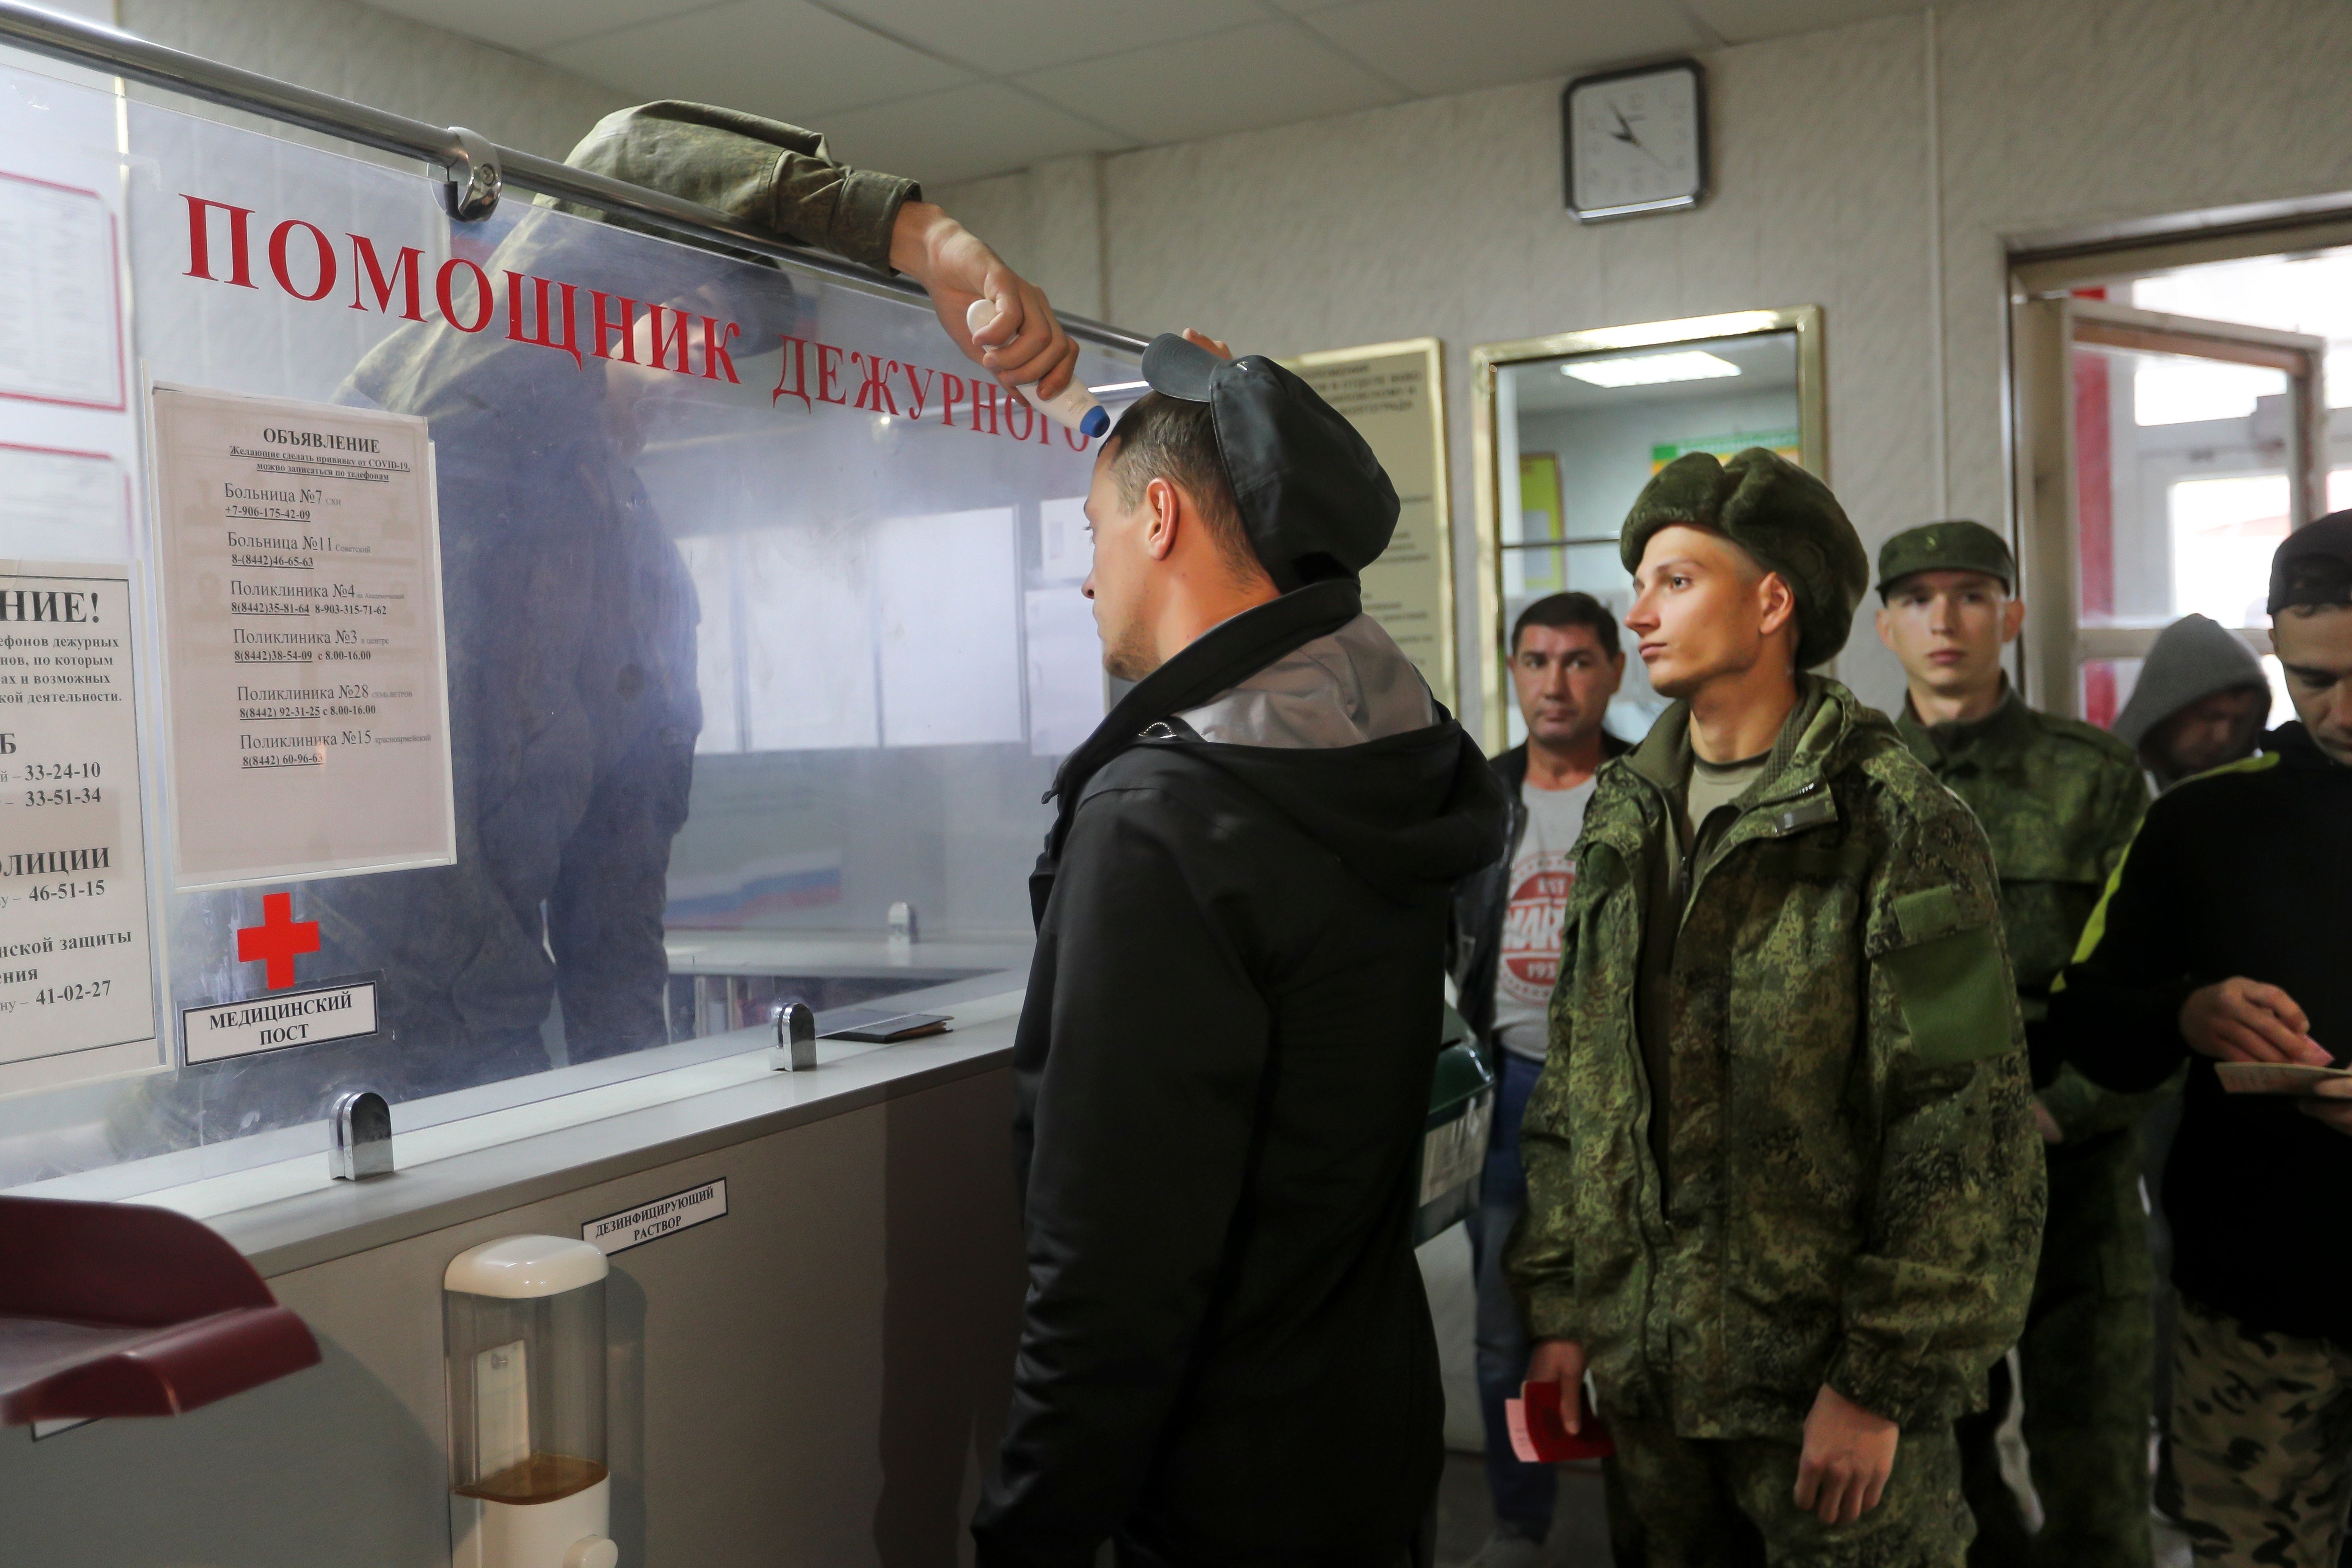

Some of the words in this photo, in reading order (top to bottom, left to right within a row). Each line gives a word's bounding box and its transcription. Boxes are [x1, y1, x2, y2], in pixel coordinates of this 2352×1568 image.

[178, 193, 742, 384] ПОМОЩНИК
[263, 428, 380, 453] ОБЪЯВЛЕНИЕ
[230, 445, 280, 458] Желающие
[282, 453, 314, 461] сделать
[317, 456, 355, 465] прививку
[288, 466, 333, 475] записаться
[347, 471, 389, 480] телефонам
[224, 482, 295, 503] Больница
[300, 488, 322, 505] №7
[226, 505, 310, 520] +7-906-175-42-09
[227, 531, 297, 550] Больница
[303, 536, 331, 551] №11
[335, 545, 371, 554] Советский
[232, 554, 313, 567] 8-(8442)46-65-63
[230, 580, 328, 597] Поликлиника
[333, 584, 355, 598] №4
[231, 603, 309, 614] 8(8442)35-81-64
[315, 605, 386, 615] 8-903-315-71-62
[53, 638, 119, 650] дежурных
[233, 628, 331, 644] Поликлиника
[335, 630, 357, 644] №3
[34, 656, 50, 665] по
[55, 656, 113, 668] которым
[235, 650, 312, 661] 8(8442)38-54-09
[325, 650, 371, 660] 8.00-16.00
[0, 676, 17, 684] ах
[21, 676, 29, 684] и
[34, 675, 111, 684] возможных
[28, 692, 122, 704] деятельности.
[237, 686, 334, 701] Поликлиника
[339, 684, 369, 699] №28
[280, 706, 320, 717] 92-31-25
[330, 705, 376, 715] 8.00-16.00
[240, 734, 337, 749] Поликлиника
[341, 730, 371, 745] №15
[24, 762, 101, 781] 33-24-10
[25, 787, 101, 807] 33-51-34
[0, 847, 111, 876] ЛИЦИИ
[29, 879, 105, 901] 46-51-15
[60, 931, 132, 950] защиты
[0, 968, 38, 984] ния
[36, 980, 110, 1005] 41-02-27
[209, 990, 352, 1030] МЕДИЦИНСКИЙ
[260, 1024, 309, 1045] ПОСТ
[595, 1185, 714, 1238] ДЕЗИНФИЦИРУЮЩИЙ
[634, 1216, 681, 1241] РАСТВОР
